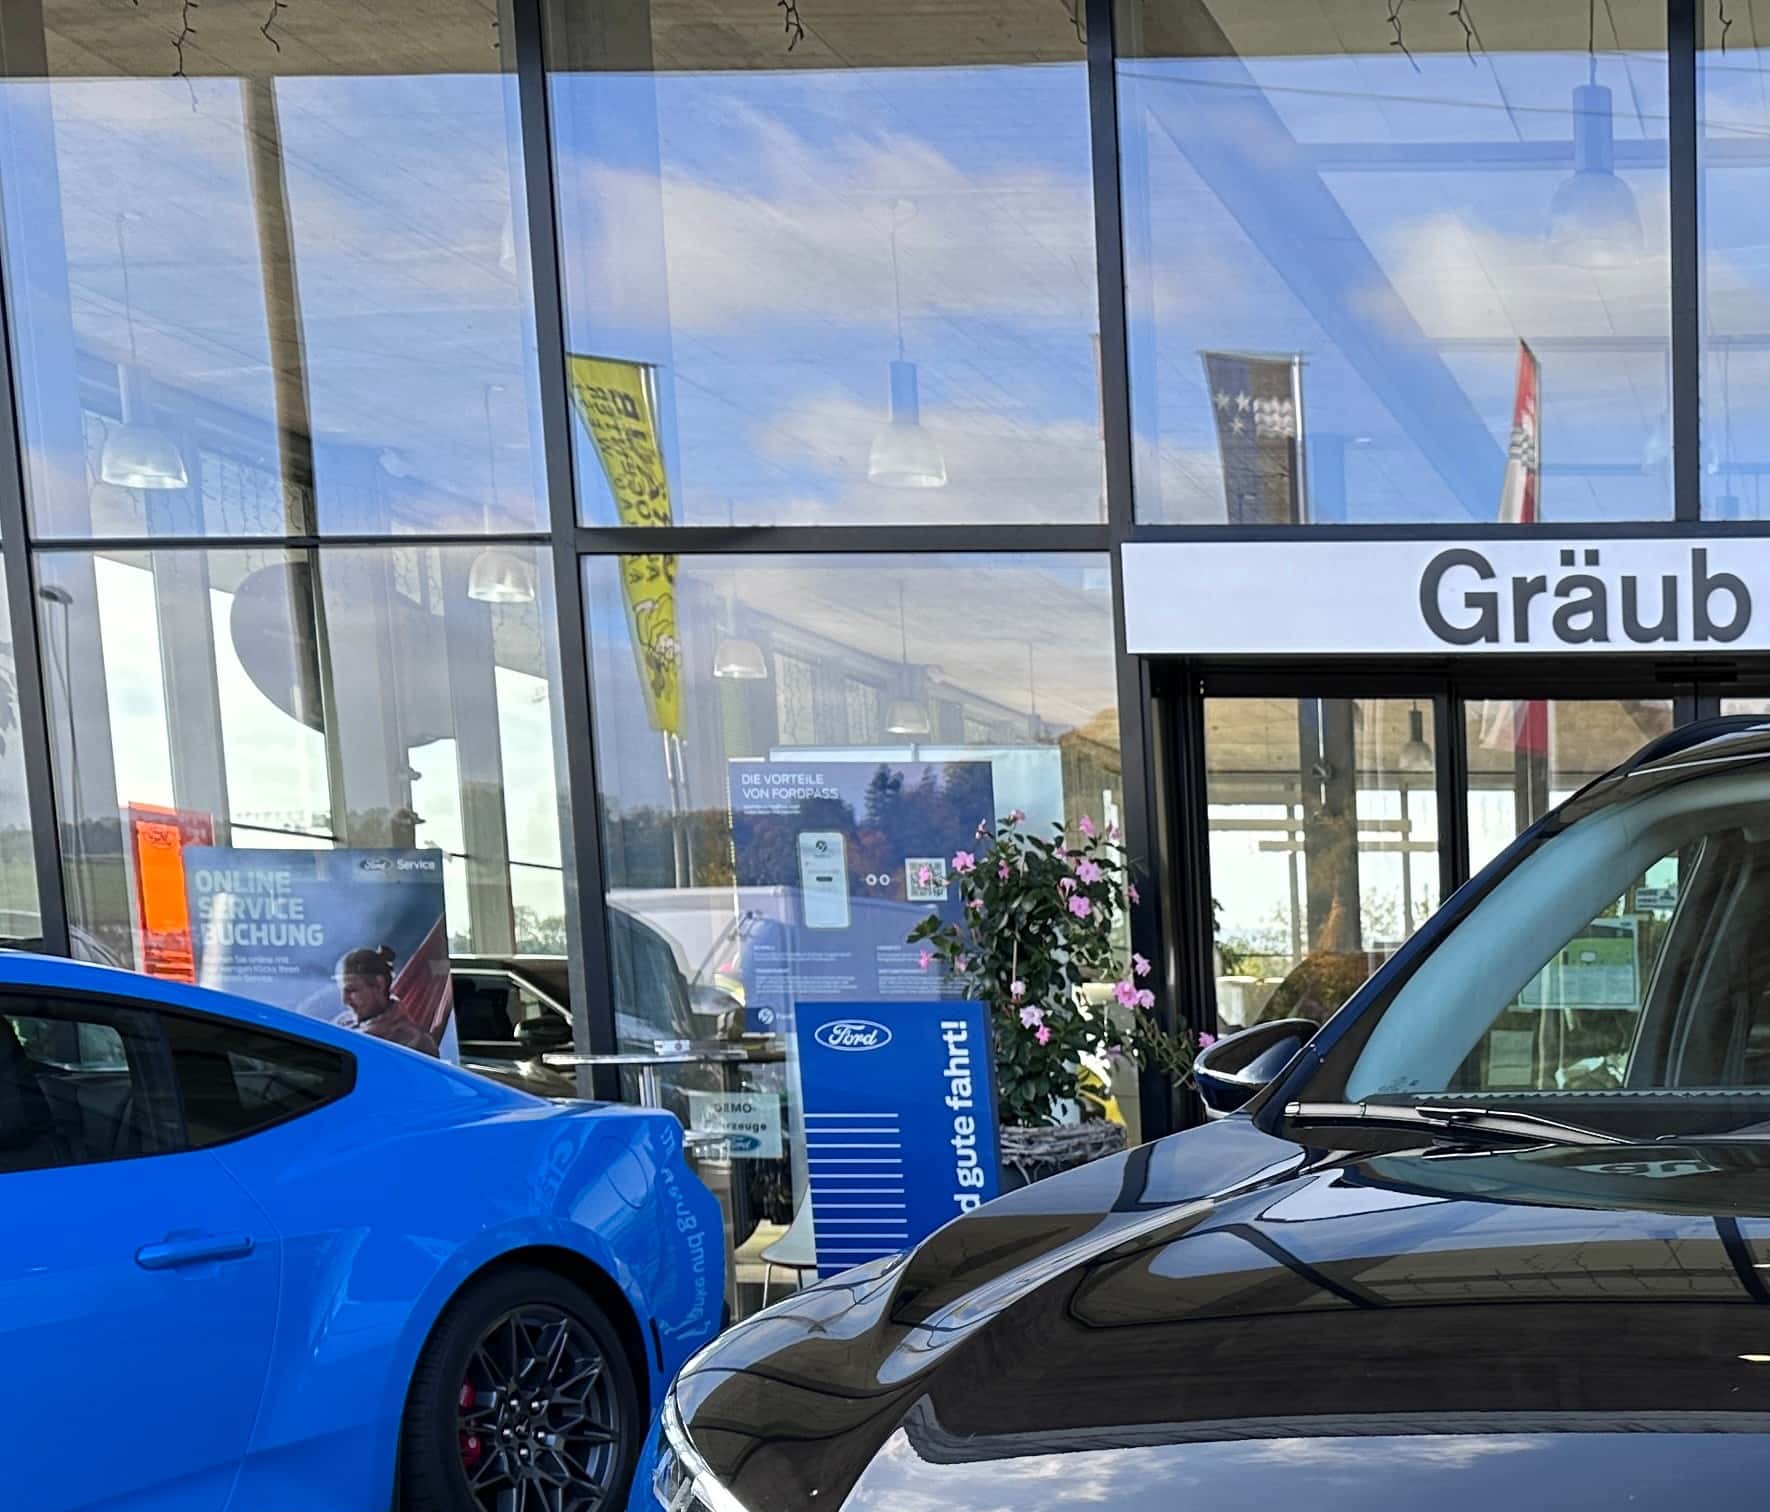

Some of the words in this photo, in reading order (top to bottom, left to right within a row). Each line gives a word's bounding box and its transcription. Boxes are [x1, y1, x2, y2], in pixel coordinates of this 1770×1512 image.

[1419, 546, 1753, 645] Gräub
[741, 773, 761, 785] DIE
[763, 773, 825, 785] VORTEILE
[742, 787, 770, 799] VON
[772, 787, 840, 799] FORDPASS
[397, 859, 436, 871] Service
[195, 870, 293, 894] ONLINE
[198, 897, 305, 921] SERVICE
[203, 922, 324, 948] BUCHUNG
[827, 1023, 879, 1046] Ford
[940, 1020, 974, 1111] fahrt!
[950, 1115, 985, 1189] gute
